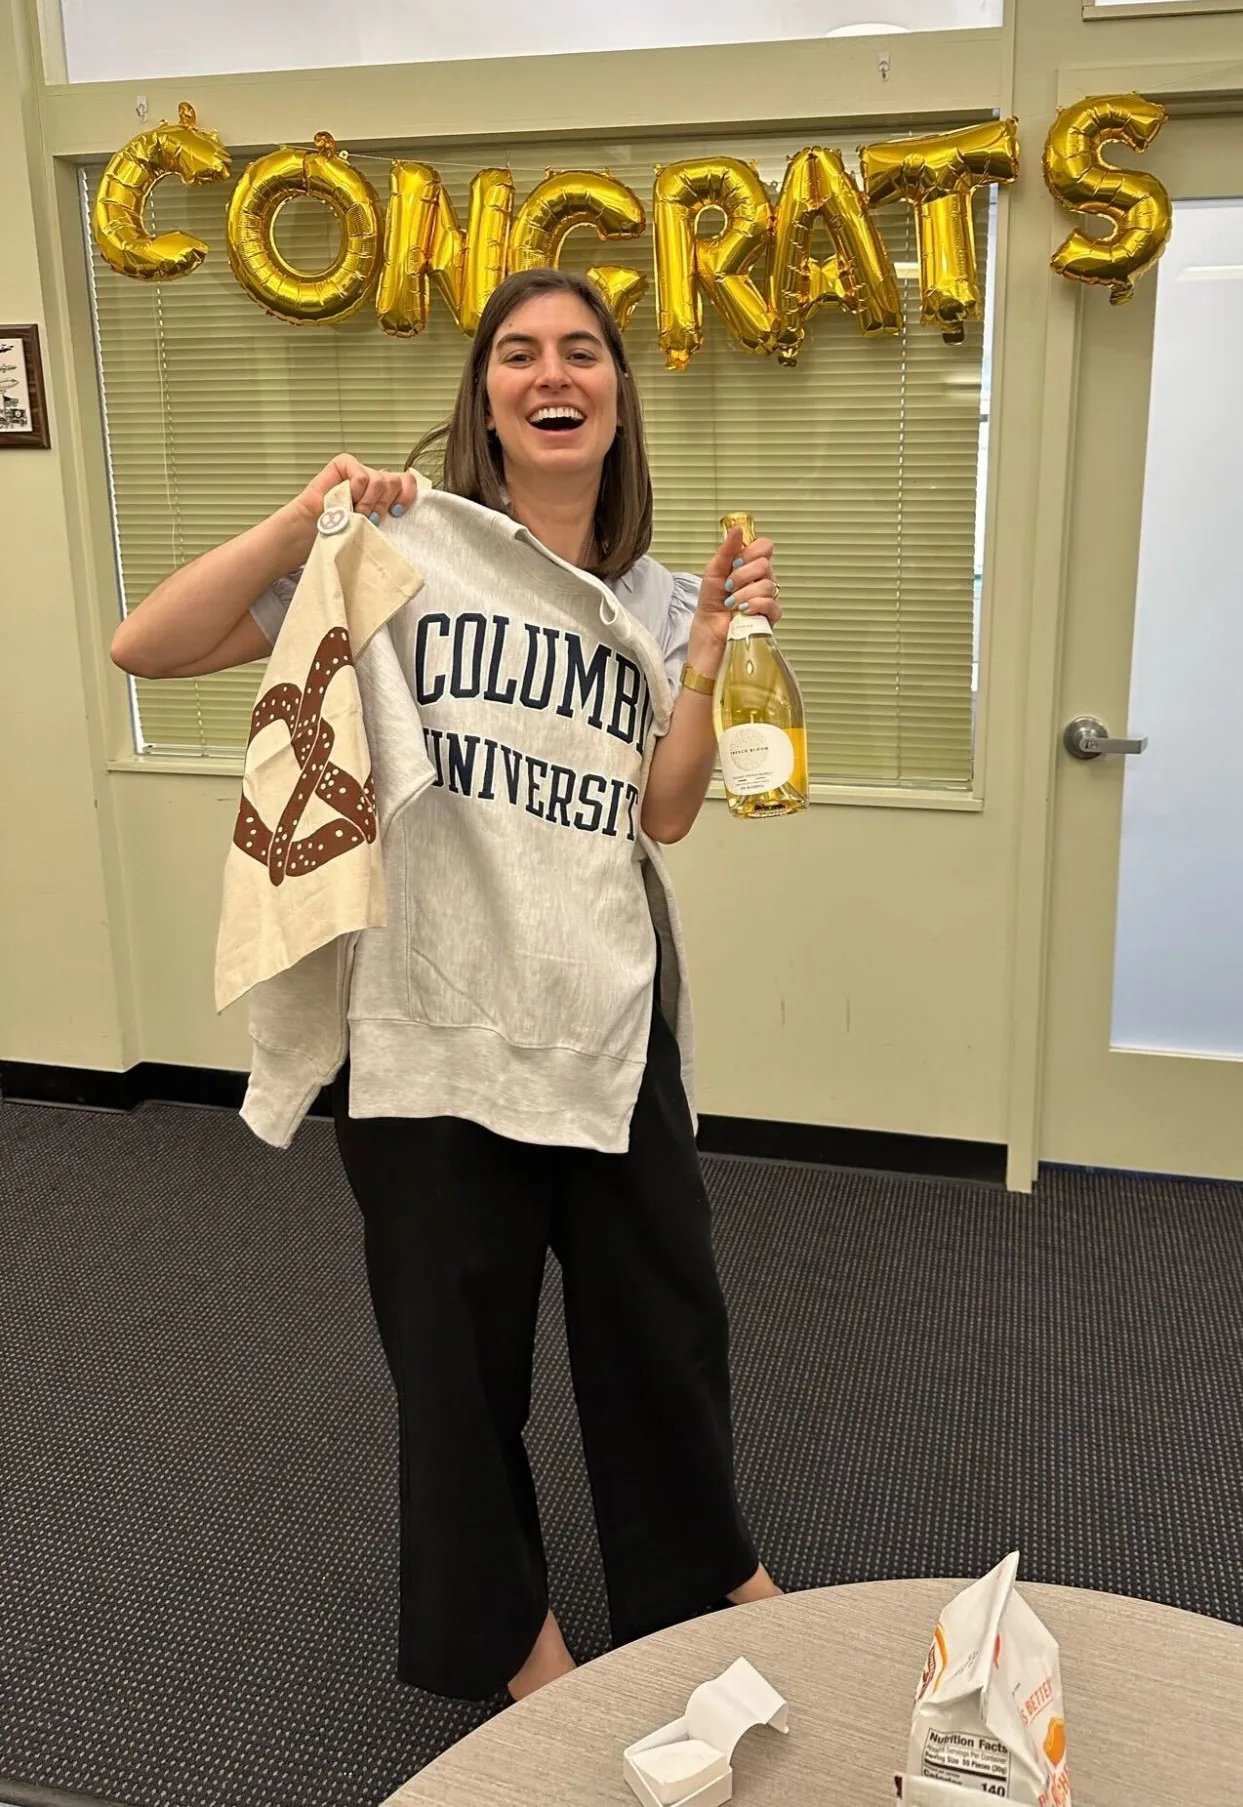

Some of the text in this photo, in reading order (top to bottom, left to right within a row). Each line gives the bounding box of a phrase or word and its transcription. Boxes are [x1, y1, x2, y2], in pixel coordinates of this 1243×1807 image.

[92, 92, 1173, 370] CONGRATS
[929, 1732, 974, 1748] Nutrition
[979, 1739, 1008, 1754] Facts
[981, 1782, 1006, 1798] 140
